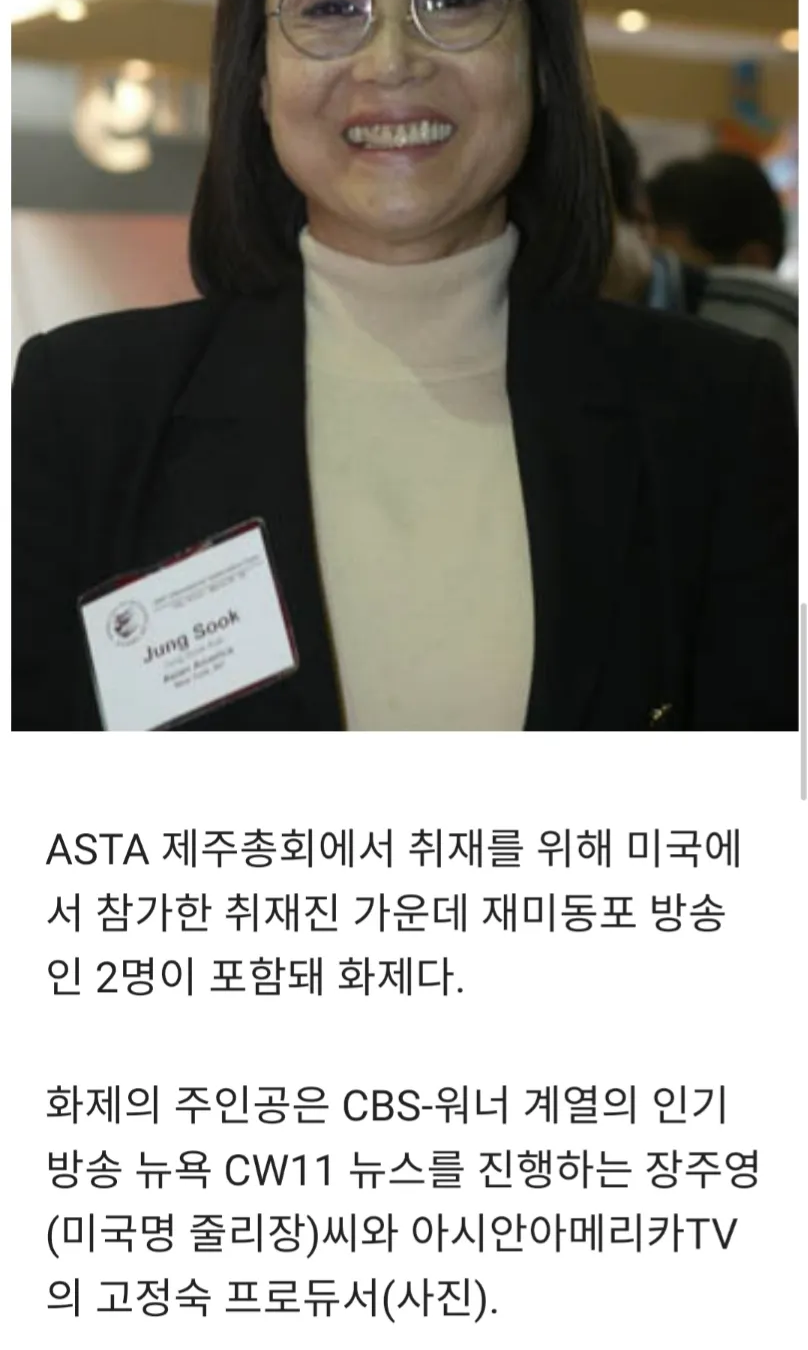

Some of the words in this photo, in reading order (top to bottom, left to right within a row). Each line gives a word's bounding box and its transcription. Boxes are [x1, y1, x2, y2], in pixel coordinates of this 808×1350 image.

[143, 634, 190, 665] Jung
[193, 609, 240, 640] Sook
[46, 833, 149, 865] ASTA
[163, 828, 392, 868] 제주총회에서
[409, 828, 523, 868] 취재를
[538, 828, 610, 868] 위해
[629, 828, 739, 868] 미국에
[48, 893, 79, 932] 서
[97, 893, 212, 932] 참가한
[226, 893, 337, 932] 취재진
[355, 893, 466, 932] 가운데
[483, 893, 636, 932] 재미동포
[652, 893, 725, 932] 방송
[48, 957, 80, 995] 인
[97, 957, 192, 996] 2명이
[210, 957, 322, 996] 포함돼
[339, 957, 463, 996] 화제다.
[47, 1085, 158, 1124] 화제의
[176, 1085, 329, 1124] 주인공은
[344, 1085, 506, 1124] CBS-워너
[525, 1085, 635, 1124] 계열의
[654, 1085, 724, 1124] 인기
[49, 1149, 122, 1189] 방송
[136, 1150, 211, 1189] 뉴욕
[226, 1154, 329, 1186] CW11
[350, 1151, 464, 1189] 뉴스를
[479, 1150, 632, 1189] 진행하는
[647, 1150, 757, 1189] 장주영
[48, 1213, 173, 1259] (미국명
[190, 1213, 398, 1259] 줄리장)씨와
[413, 1213, 738, 1253] 아시안아메리카TV
[48, 1278, 79, 1317] 의
[97, 1278, 211, 1317] 고정숙
[226, 1278, 497, 1323] 프로듀서(사진).
